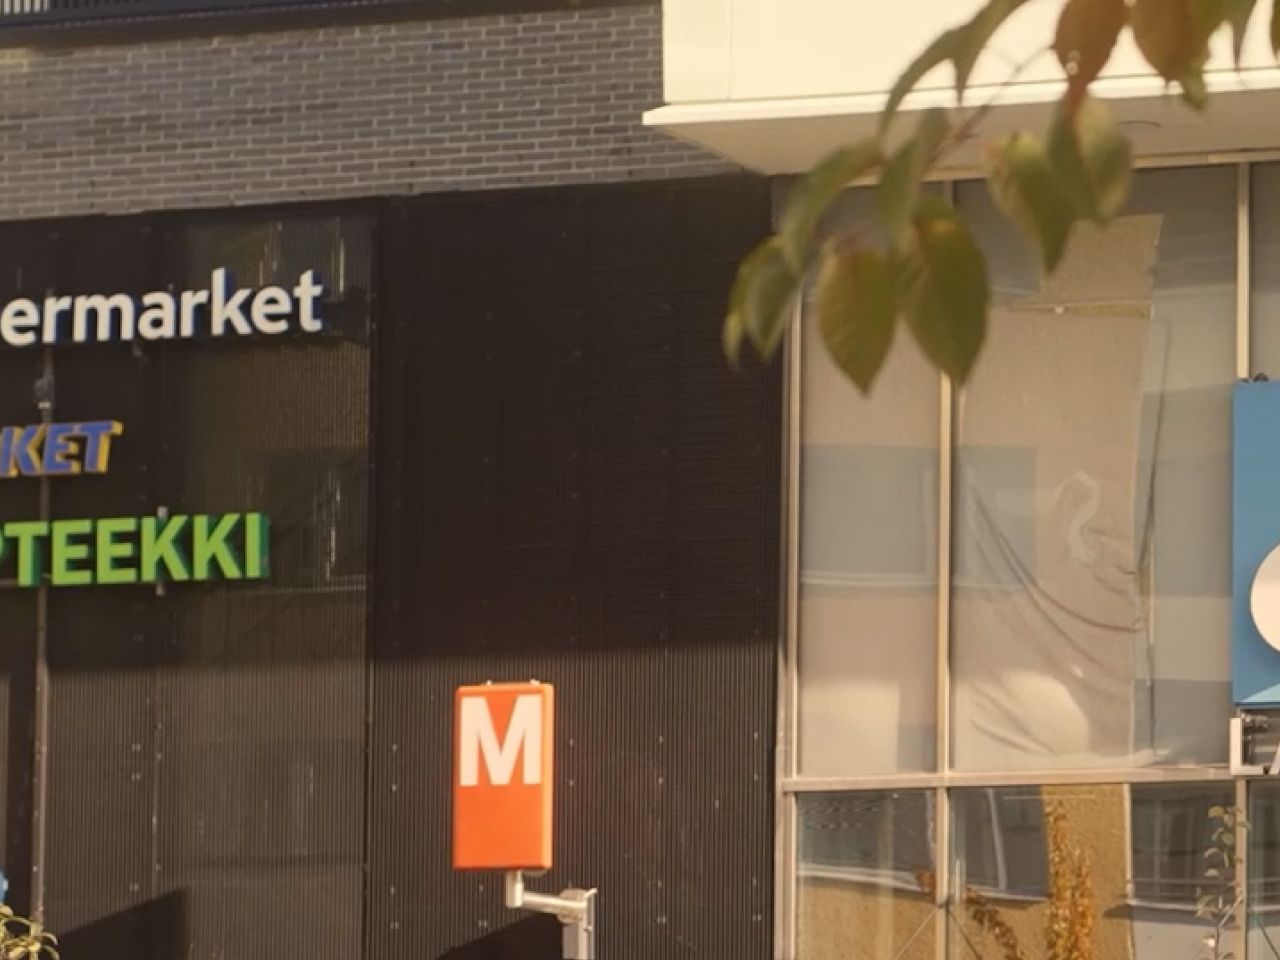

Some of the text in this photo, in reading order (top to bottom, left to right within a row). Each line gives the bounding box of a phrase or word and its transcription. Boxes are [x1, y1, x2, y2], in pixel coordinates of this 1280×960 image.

[0, 267, 323, 346] ermarket
[0, 513, 268, 587] TEEKKI
[460, 694, 542, 785] M
